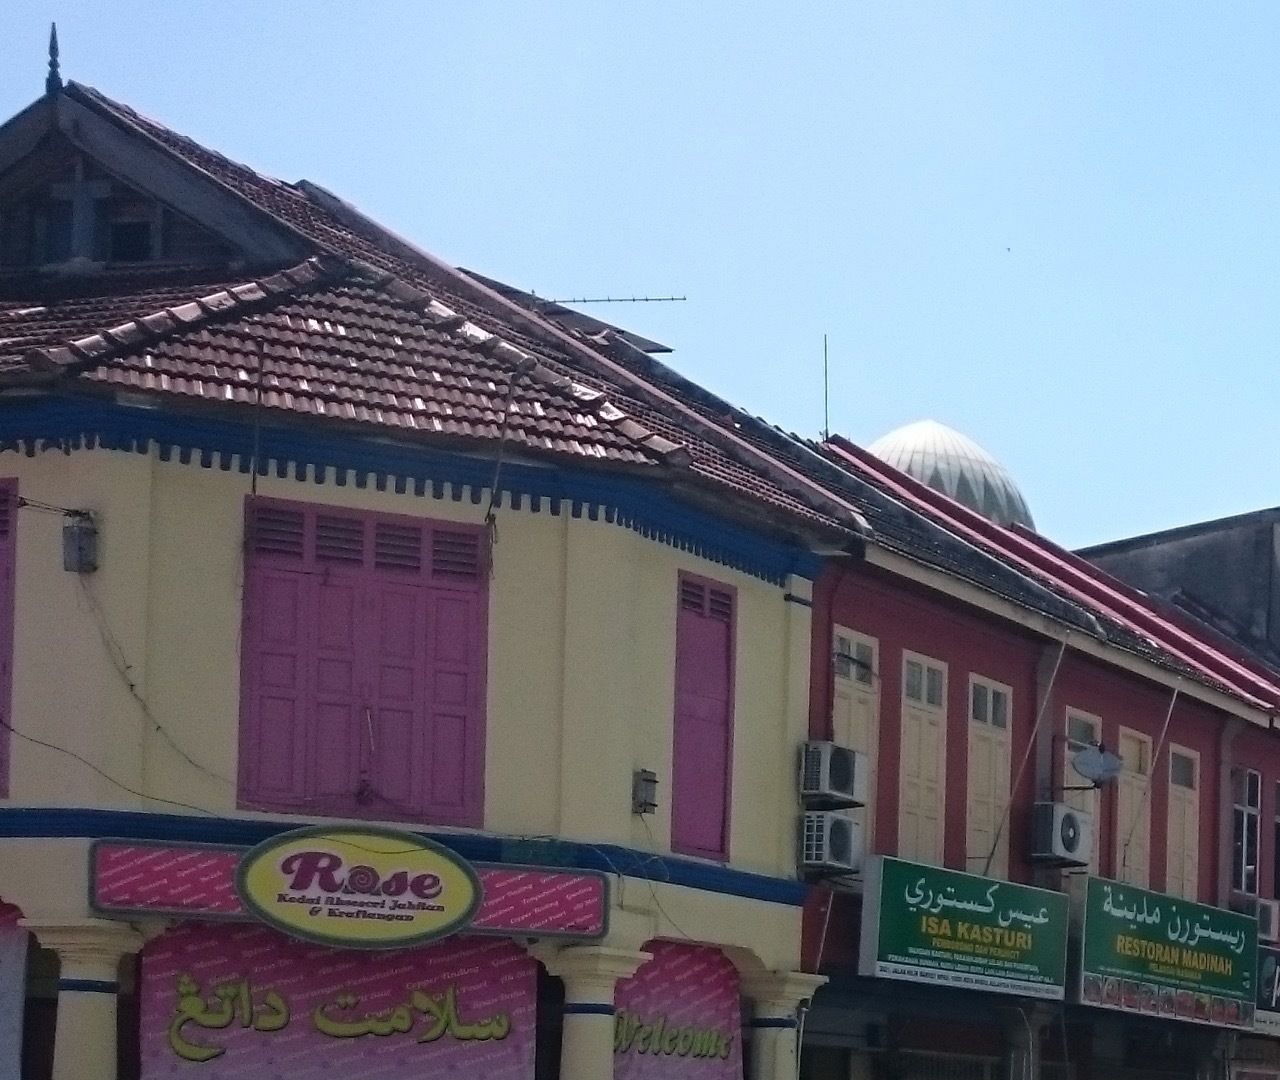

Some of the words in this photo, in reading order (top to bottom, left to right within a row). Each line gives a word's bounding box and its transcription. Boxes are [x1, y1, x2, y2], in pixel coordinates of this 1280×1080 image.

[281, 851, 443, 899] Rose
[277, 893, 321, 905] Kedai
[1103, 885, 1161, 930] مدينة
[921, 915, 951, 937] ISA
[957, 921, 1032, 950] KASTURI
[1116, 934, 1179, 964] RESTORAN
[1182, 949, 1233, 977] MADINAH
[315, 983, 511, 1044] سلامت
[613, 1011, 734, 1061] Welcome
